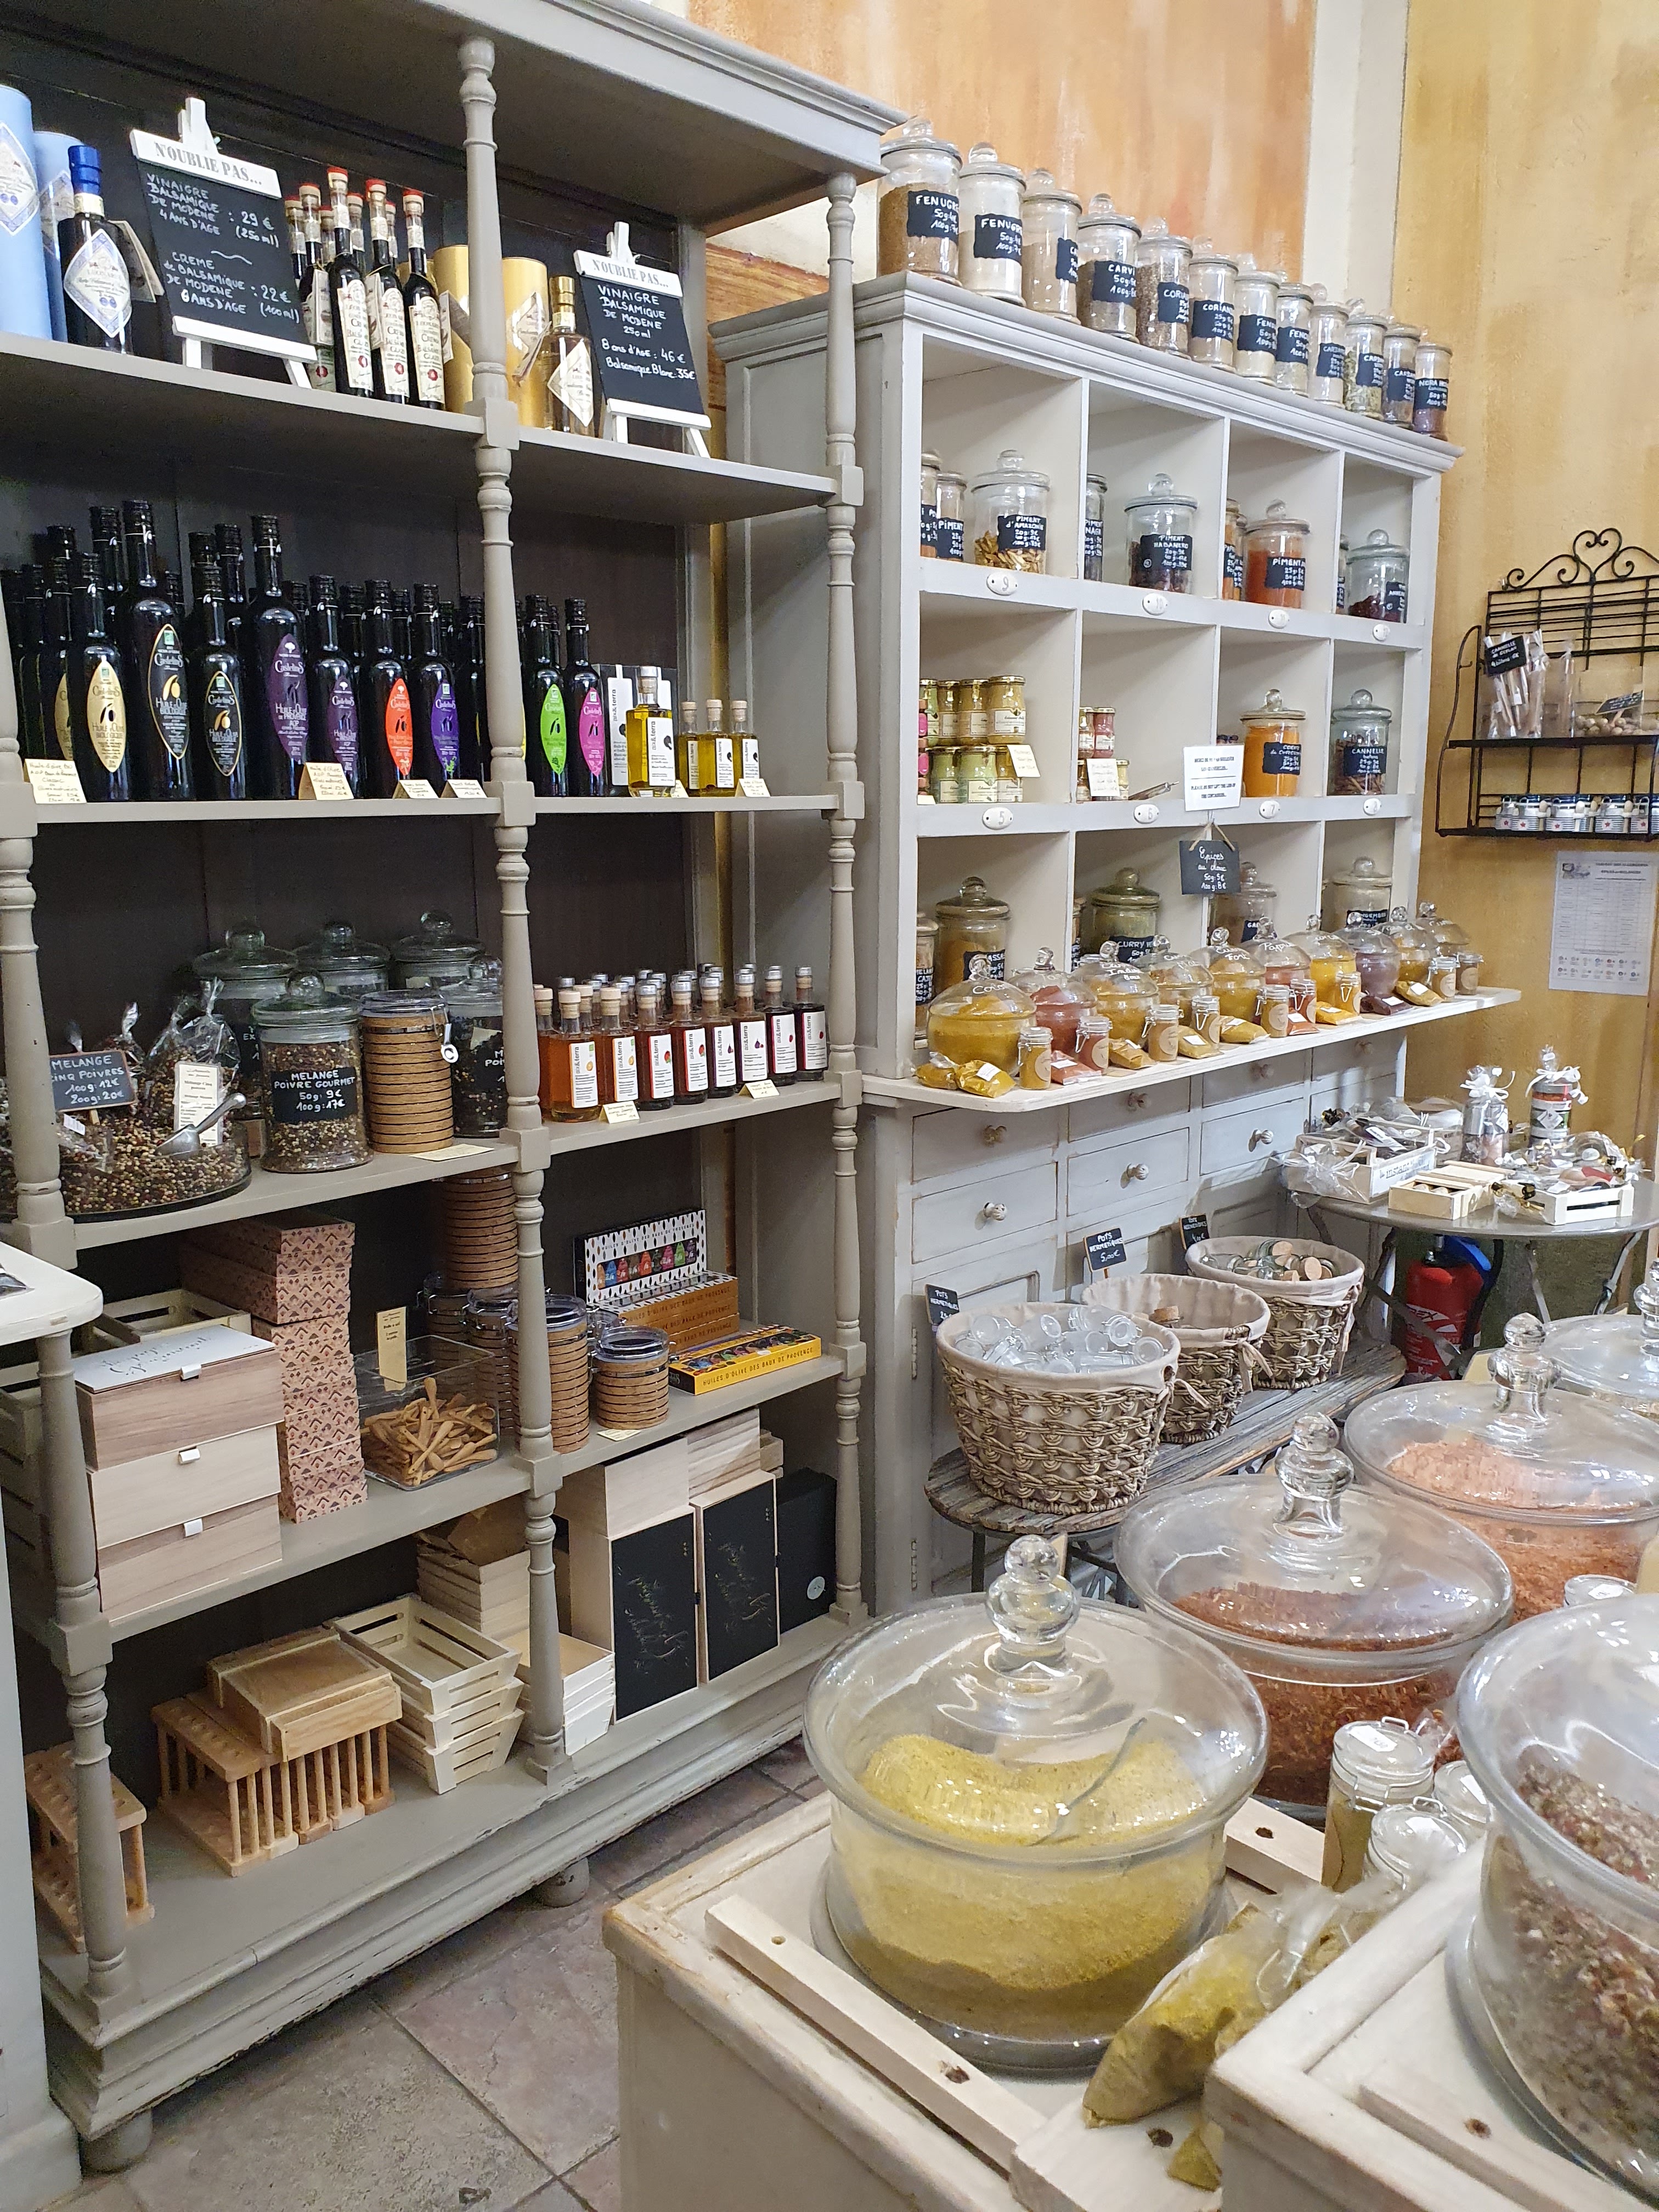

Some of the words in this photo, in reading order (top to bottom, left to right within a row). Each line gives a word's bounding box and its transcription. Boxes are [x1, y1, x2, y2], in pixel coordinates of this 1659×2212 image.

[52, 1054, 112, 1070] MELANGE
[291, 1070, 339, 1081] MELANGE
[315, 1076, 356, 1088] GOURMET
[1097, 1232, 1113, 1243] POTS
[749, 1363, 760, 1372] DES
[762, 1359, 776, 1368] BAUX
[787, 1347, 813, 1360] PROVENCE
